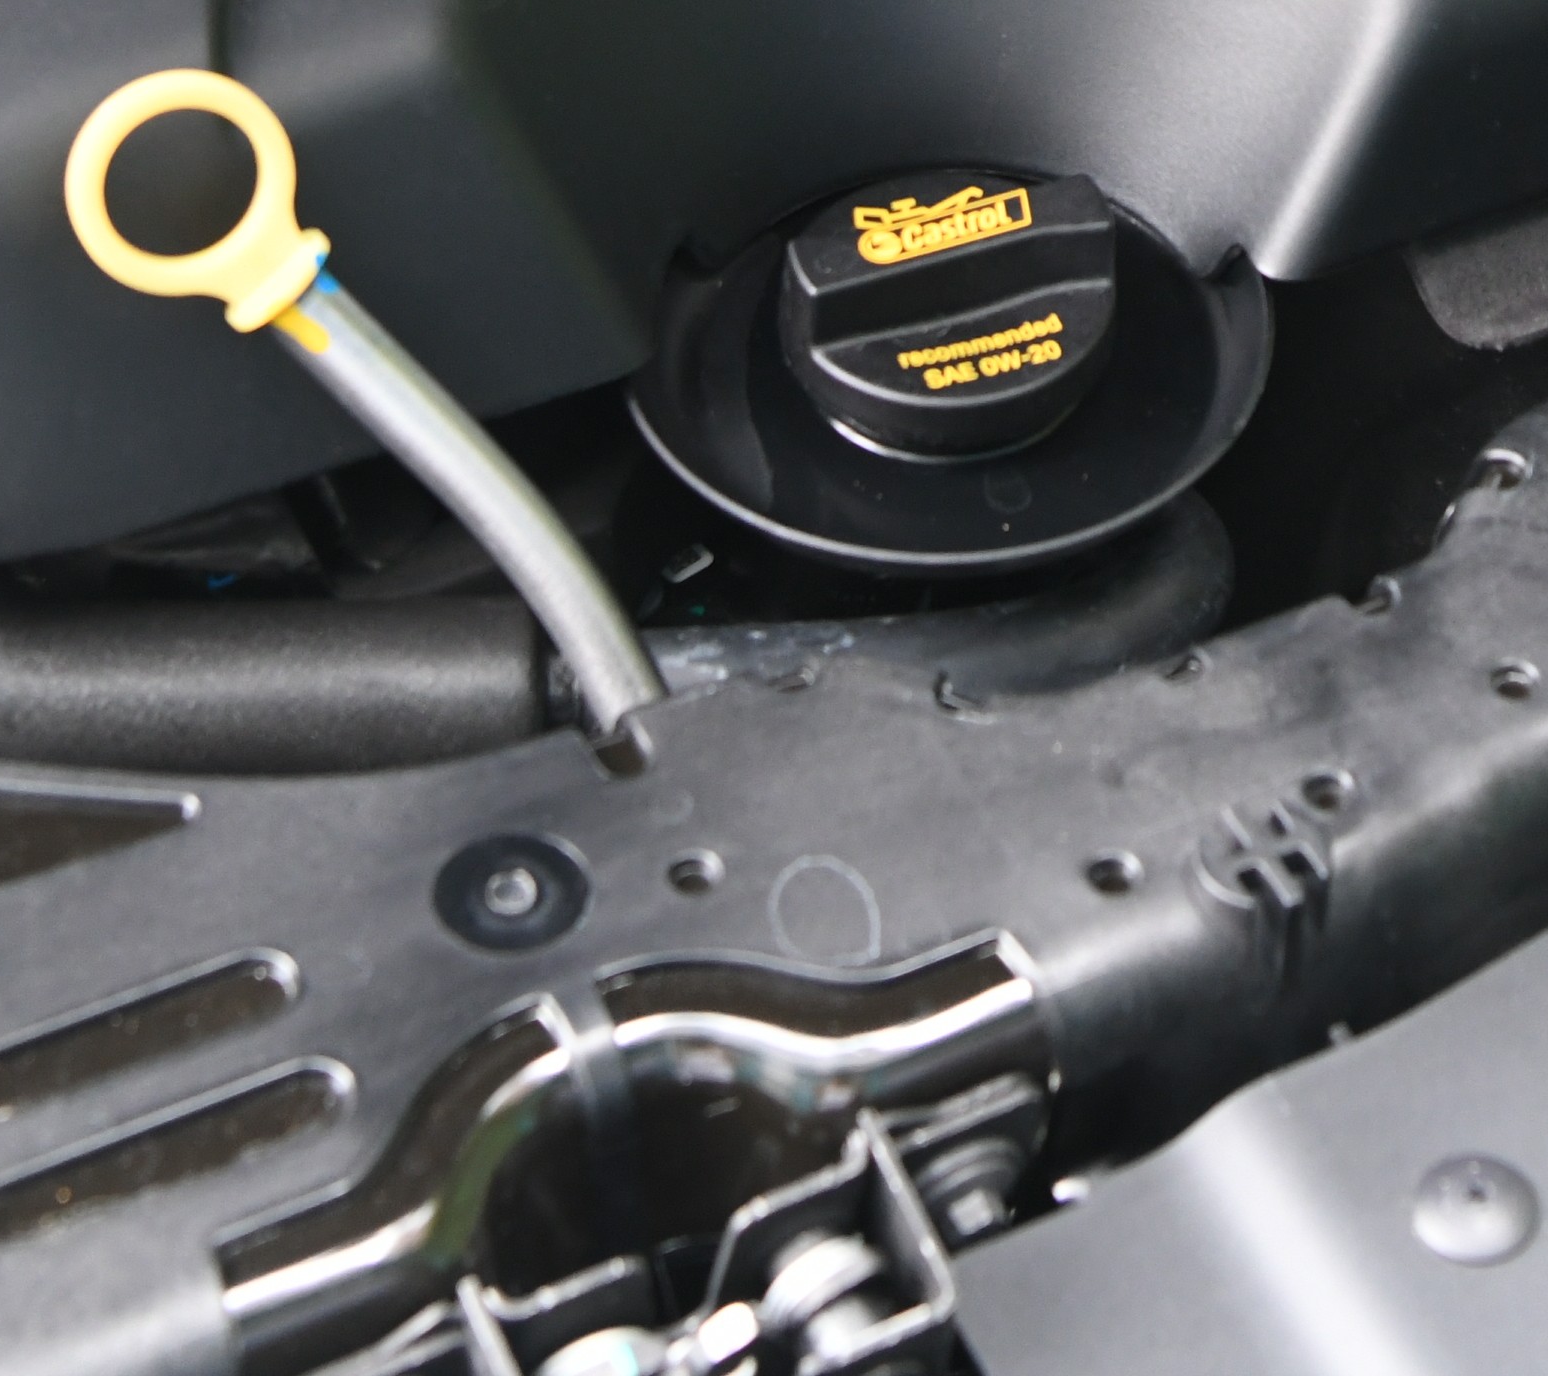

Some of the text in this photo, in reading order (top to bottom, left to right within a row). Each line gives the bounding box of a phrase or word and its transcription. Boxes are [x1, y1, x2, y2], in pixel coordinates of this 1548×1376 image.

[899, 201, 1013, 253] Castrol
[897, 312, 1064, 370] recommended
[923, 339, 1063, 390] SAE 0W-20
